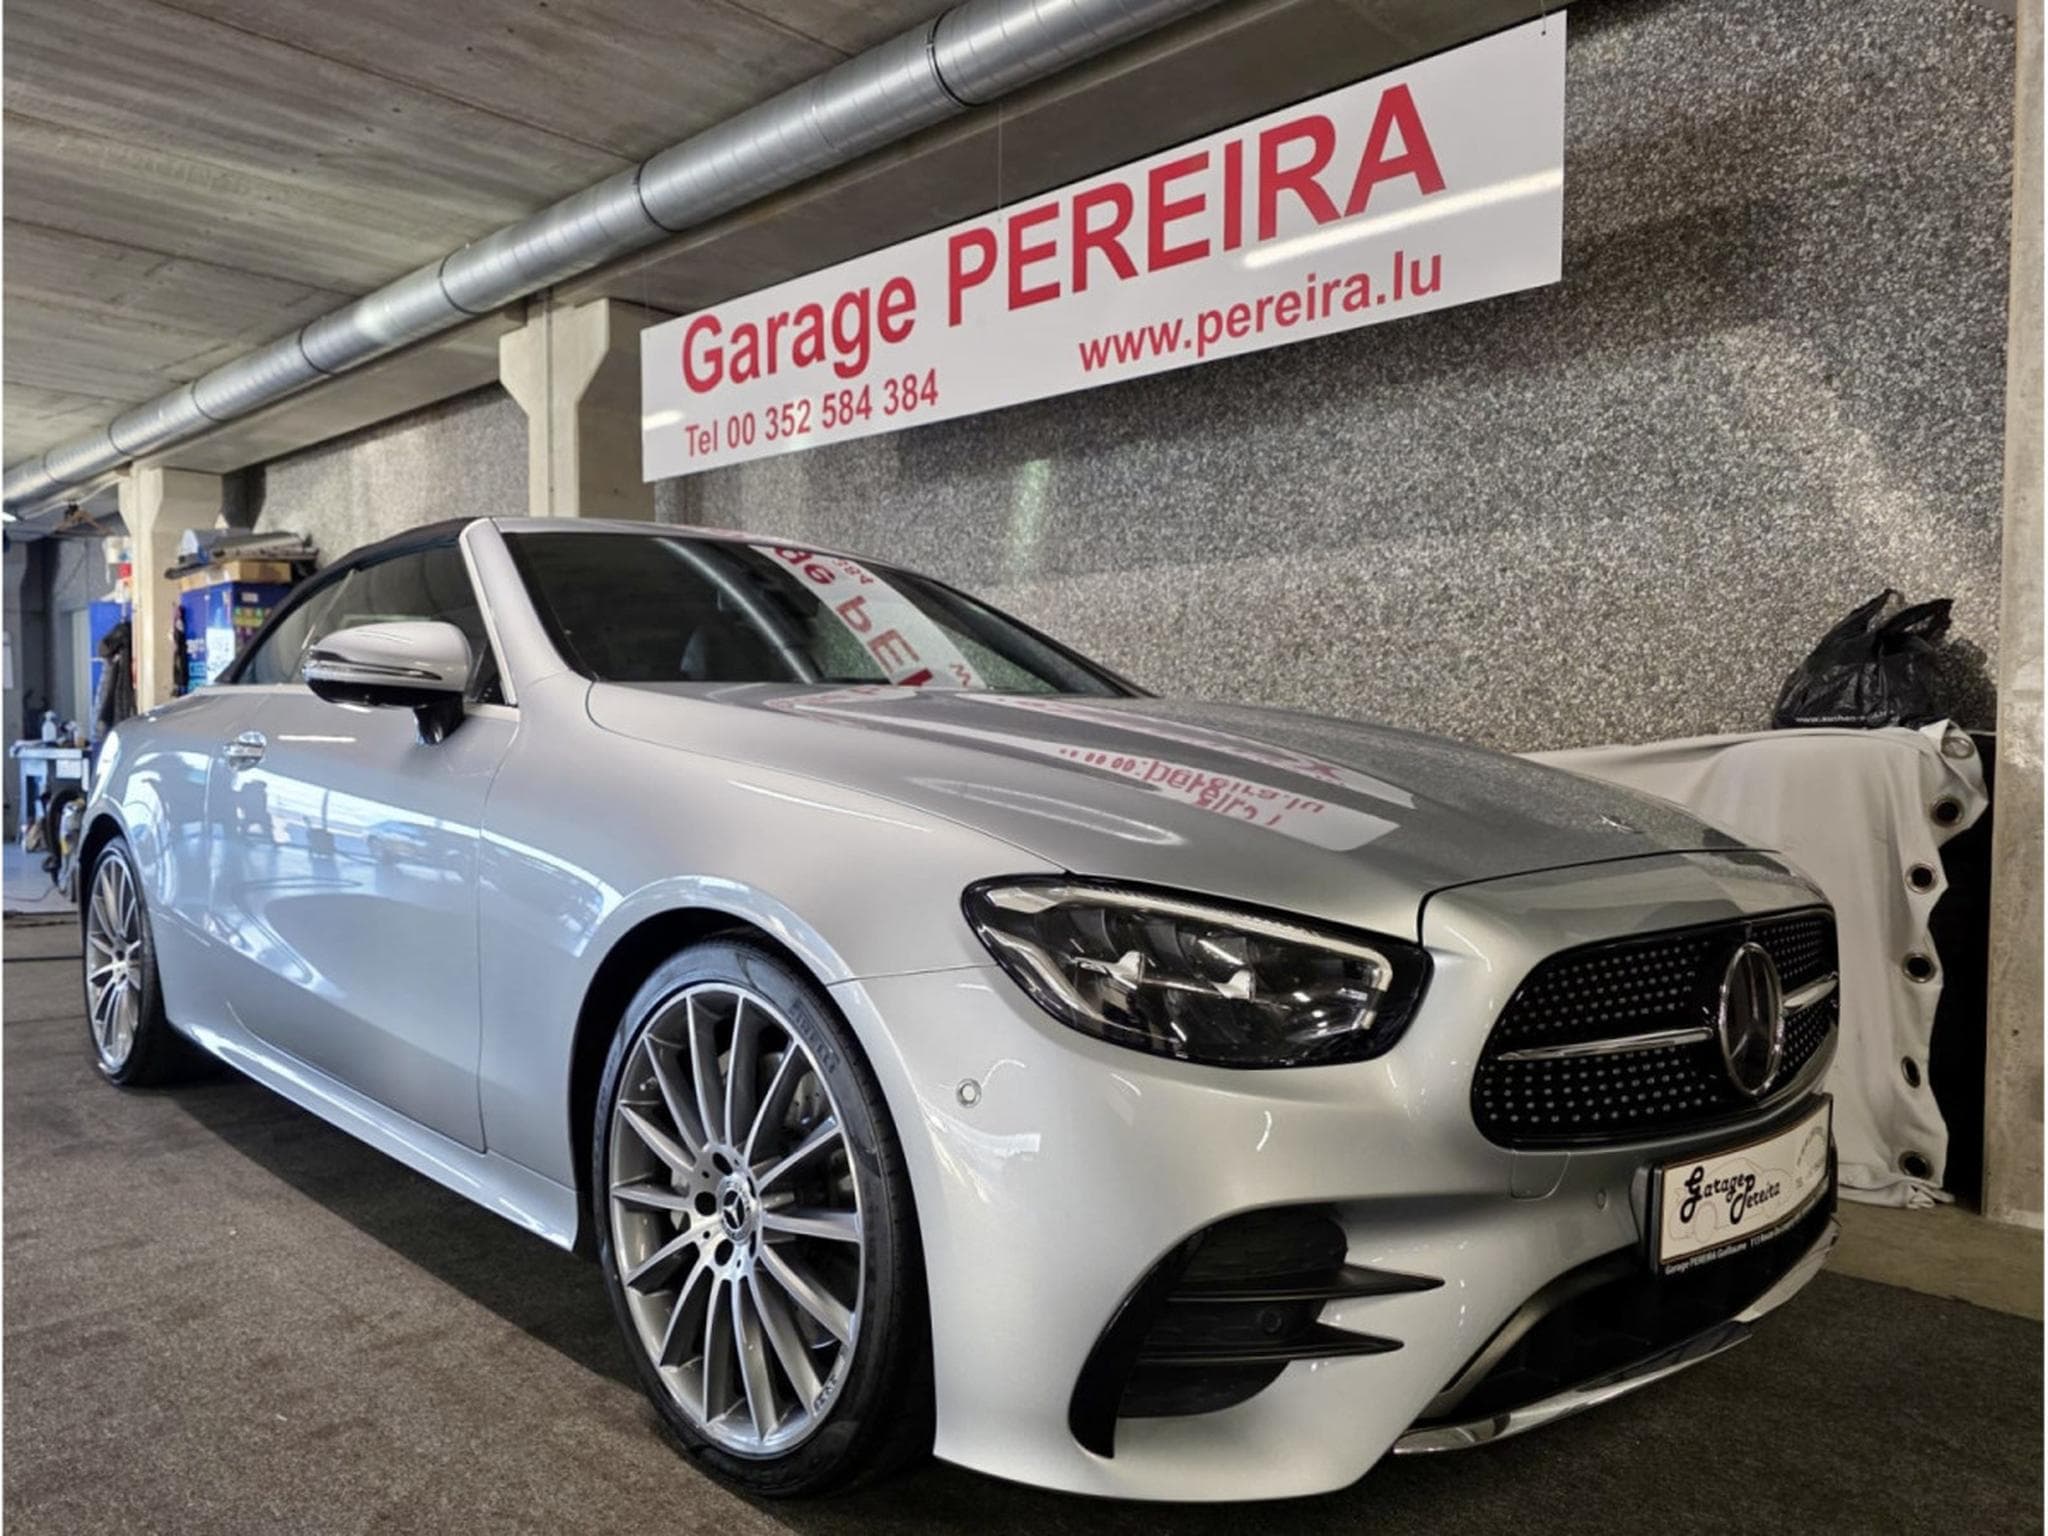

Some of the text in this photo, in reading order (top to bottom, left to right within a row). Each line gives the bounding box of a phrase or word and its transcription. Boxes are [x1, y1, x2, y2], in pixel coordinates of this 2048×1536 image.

[681, 83, 1446, 394] Garage PEREIRA
[1078, 251, 1441, 372] www.pereira.lu
[685, 368, 939, 456] Tel 00 352 584 384
[1680, 1166, 1745, 1223] Garage
